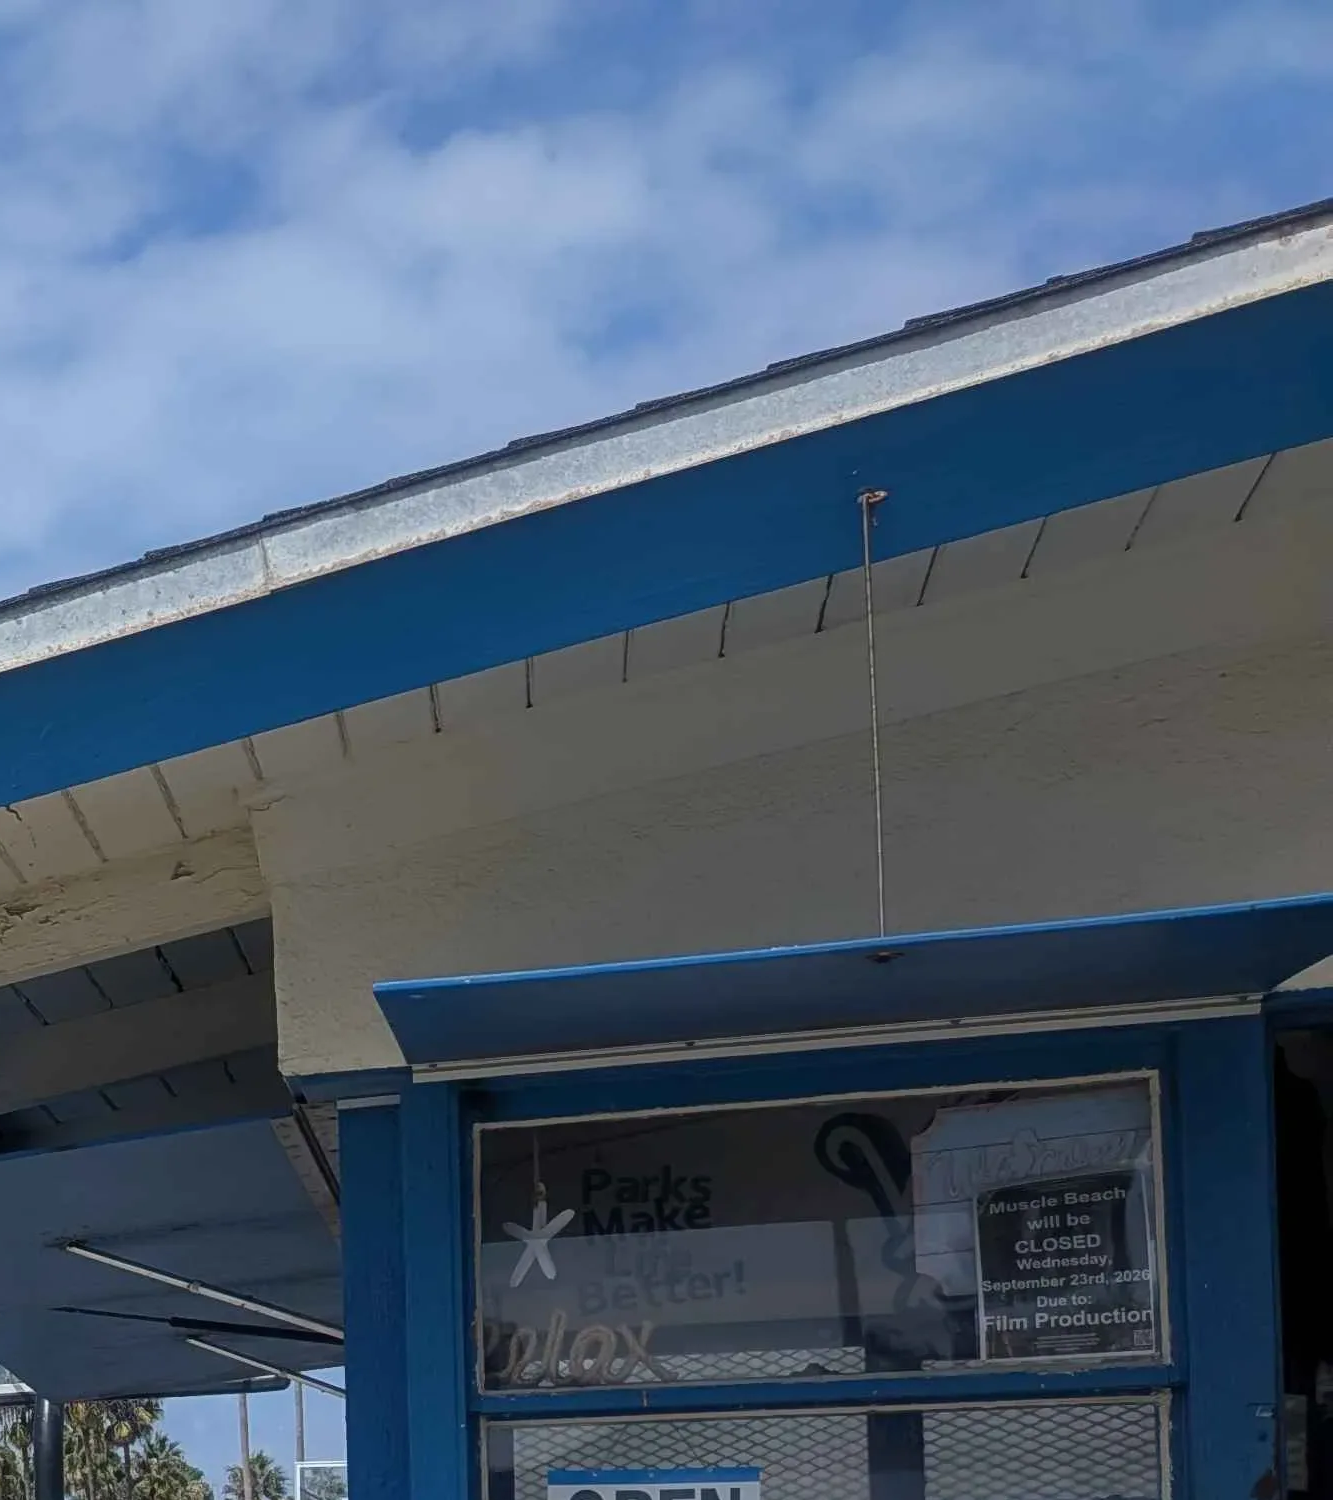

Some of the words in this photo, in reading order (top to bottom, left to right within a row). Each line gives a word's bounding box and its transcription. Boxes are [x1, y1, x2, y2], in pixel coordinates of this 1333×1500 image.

[581, 1164, 714, 1205] Parks
[989, 1196, 1058, 1215] Muscle
[1063, 1187, 1126, 1205] Beach
[581, 1198, 713, 1247] Make
[1027, 1215, 1060, 1231] will
[1067, 1213, 1091, 1227] be
[1015, 1234, 1101, 1254] CLOSED
[1016, 1254, 1113, 1271] Wednesday,
[576, 1257, 747, 1317] Better!
[982, 1276, 1066, 1293] September
[1070, 1273, 1109, 1286] 23rd,
[1036, 1296, 1068, 1308] Due
[1071, 1294, 1092, 1306] to:
[983, 1316, 1028, 1332] Film
[1035, 1307, 1153, 1329] Production
[482, 1309, 677, 1383] elax
